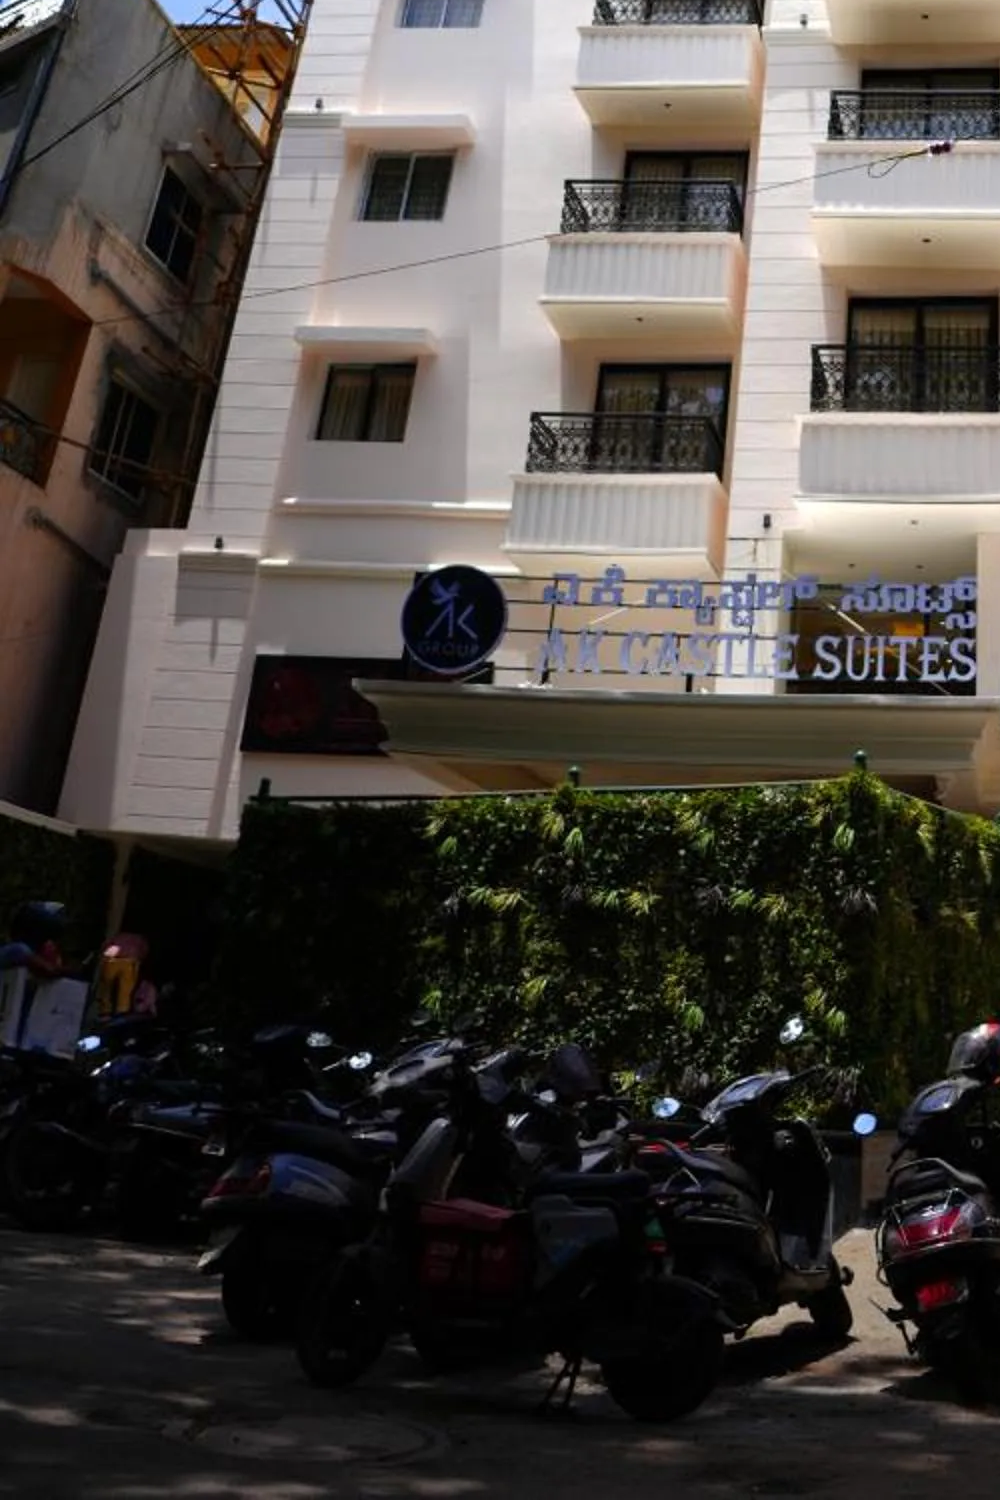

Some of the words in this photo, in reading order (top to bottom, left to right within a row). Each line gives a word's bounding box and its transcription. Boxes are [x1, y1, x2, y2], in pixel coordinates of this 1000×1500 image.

[417, 640, 480, 659] GROUP
[536, 628, 606, 674] AK
[619, 630, 801, 680] CASTLE
[812, 633, 977, 682] SUITES
